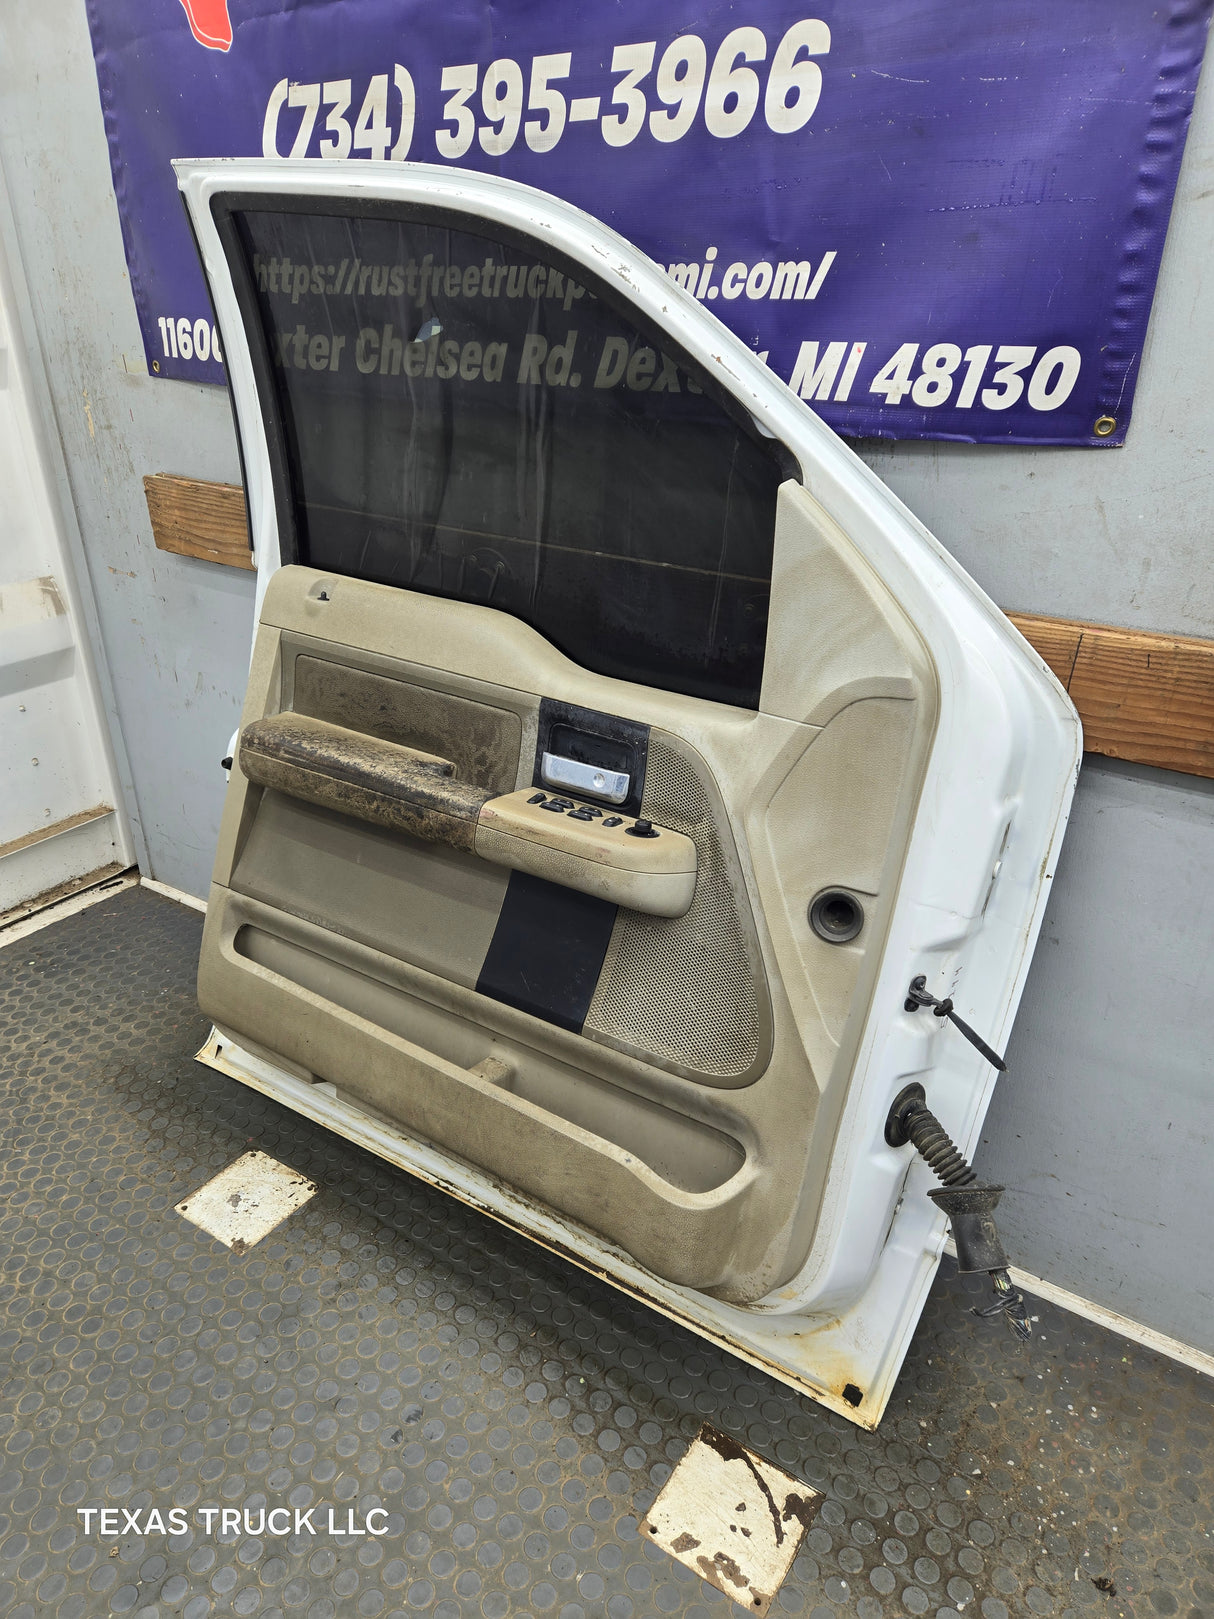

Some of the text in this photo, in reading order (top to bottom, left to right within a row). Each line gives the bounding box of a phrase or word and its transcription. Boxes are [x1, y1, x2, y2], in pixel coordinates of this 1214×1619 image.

[262, 18, 832, 161] (734) 395-3966
[356, 324, 508, 382] Chelsea
[517, 330, 582, 388] Rd.
[788, 340, 868, 402] MI
[868, 342, 1082, 412] 48130
